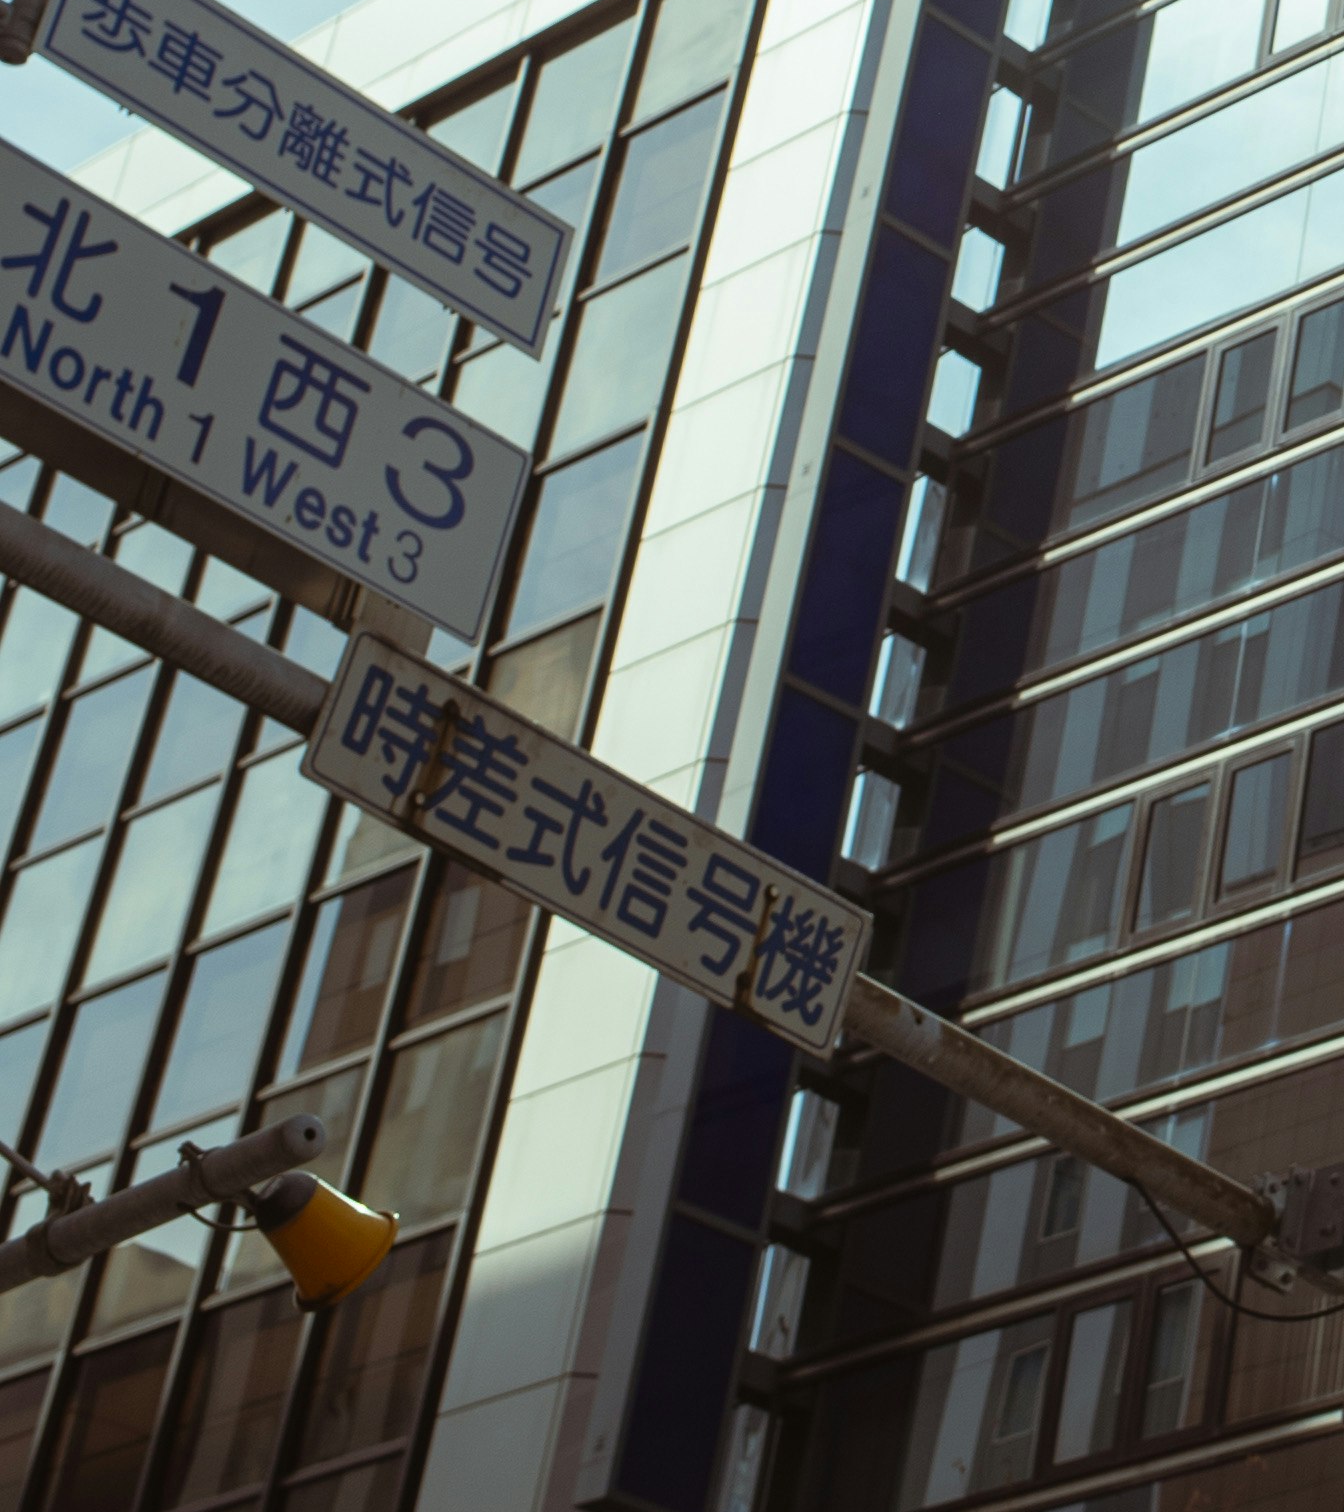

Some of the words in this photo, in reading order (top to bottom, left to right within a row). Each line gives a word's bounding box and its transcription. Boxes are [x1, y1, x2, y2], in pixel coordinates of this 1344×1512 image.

[0, 304, 165, 440] North
[188, 412, 215, 465] 1
[240, 435, 380, 563] West
[387, 530, 424, 584] 3
[341, 663, 846, 1028] 時差式信号機
